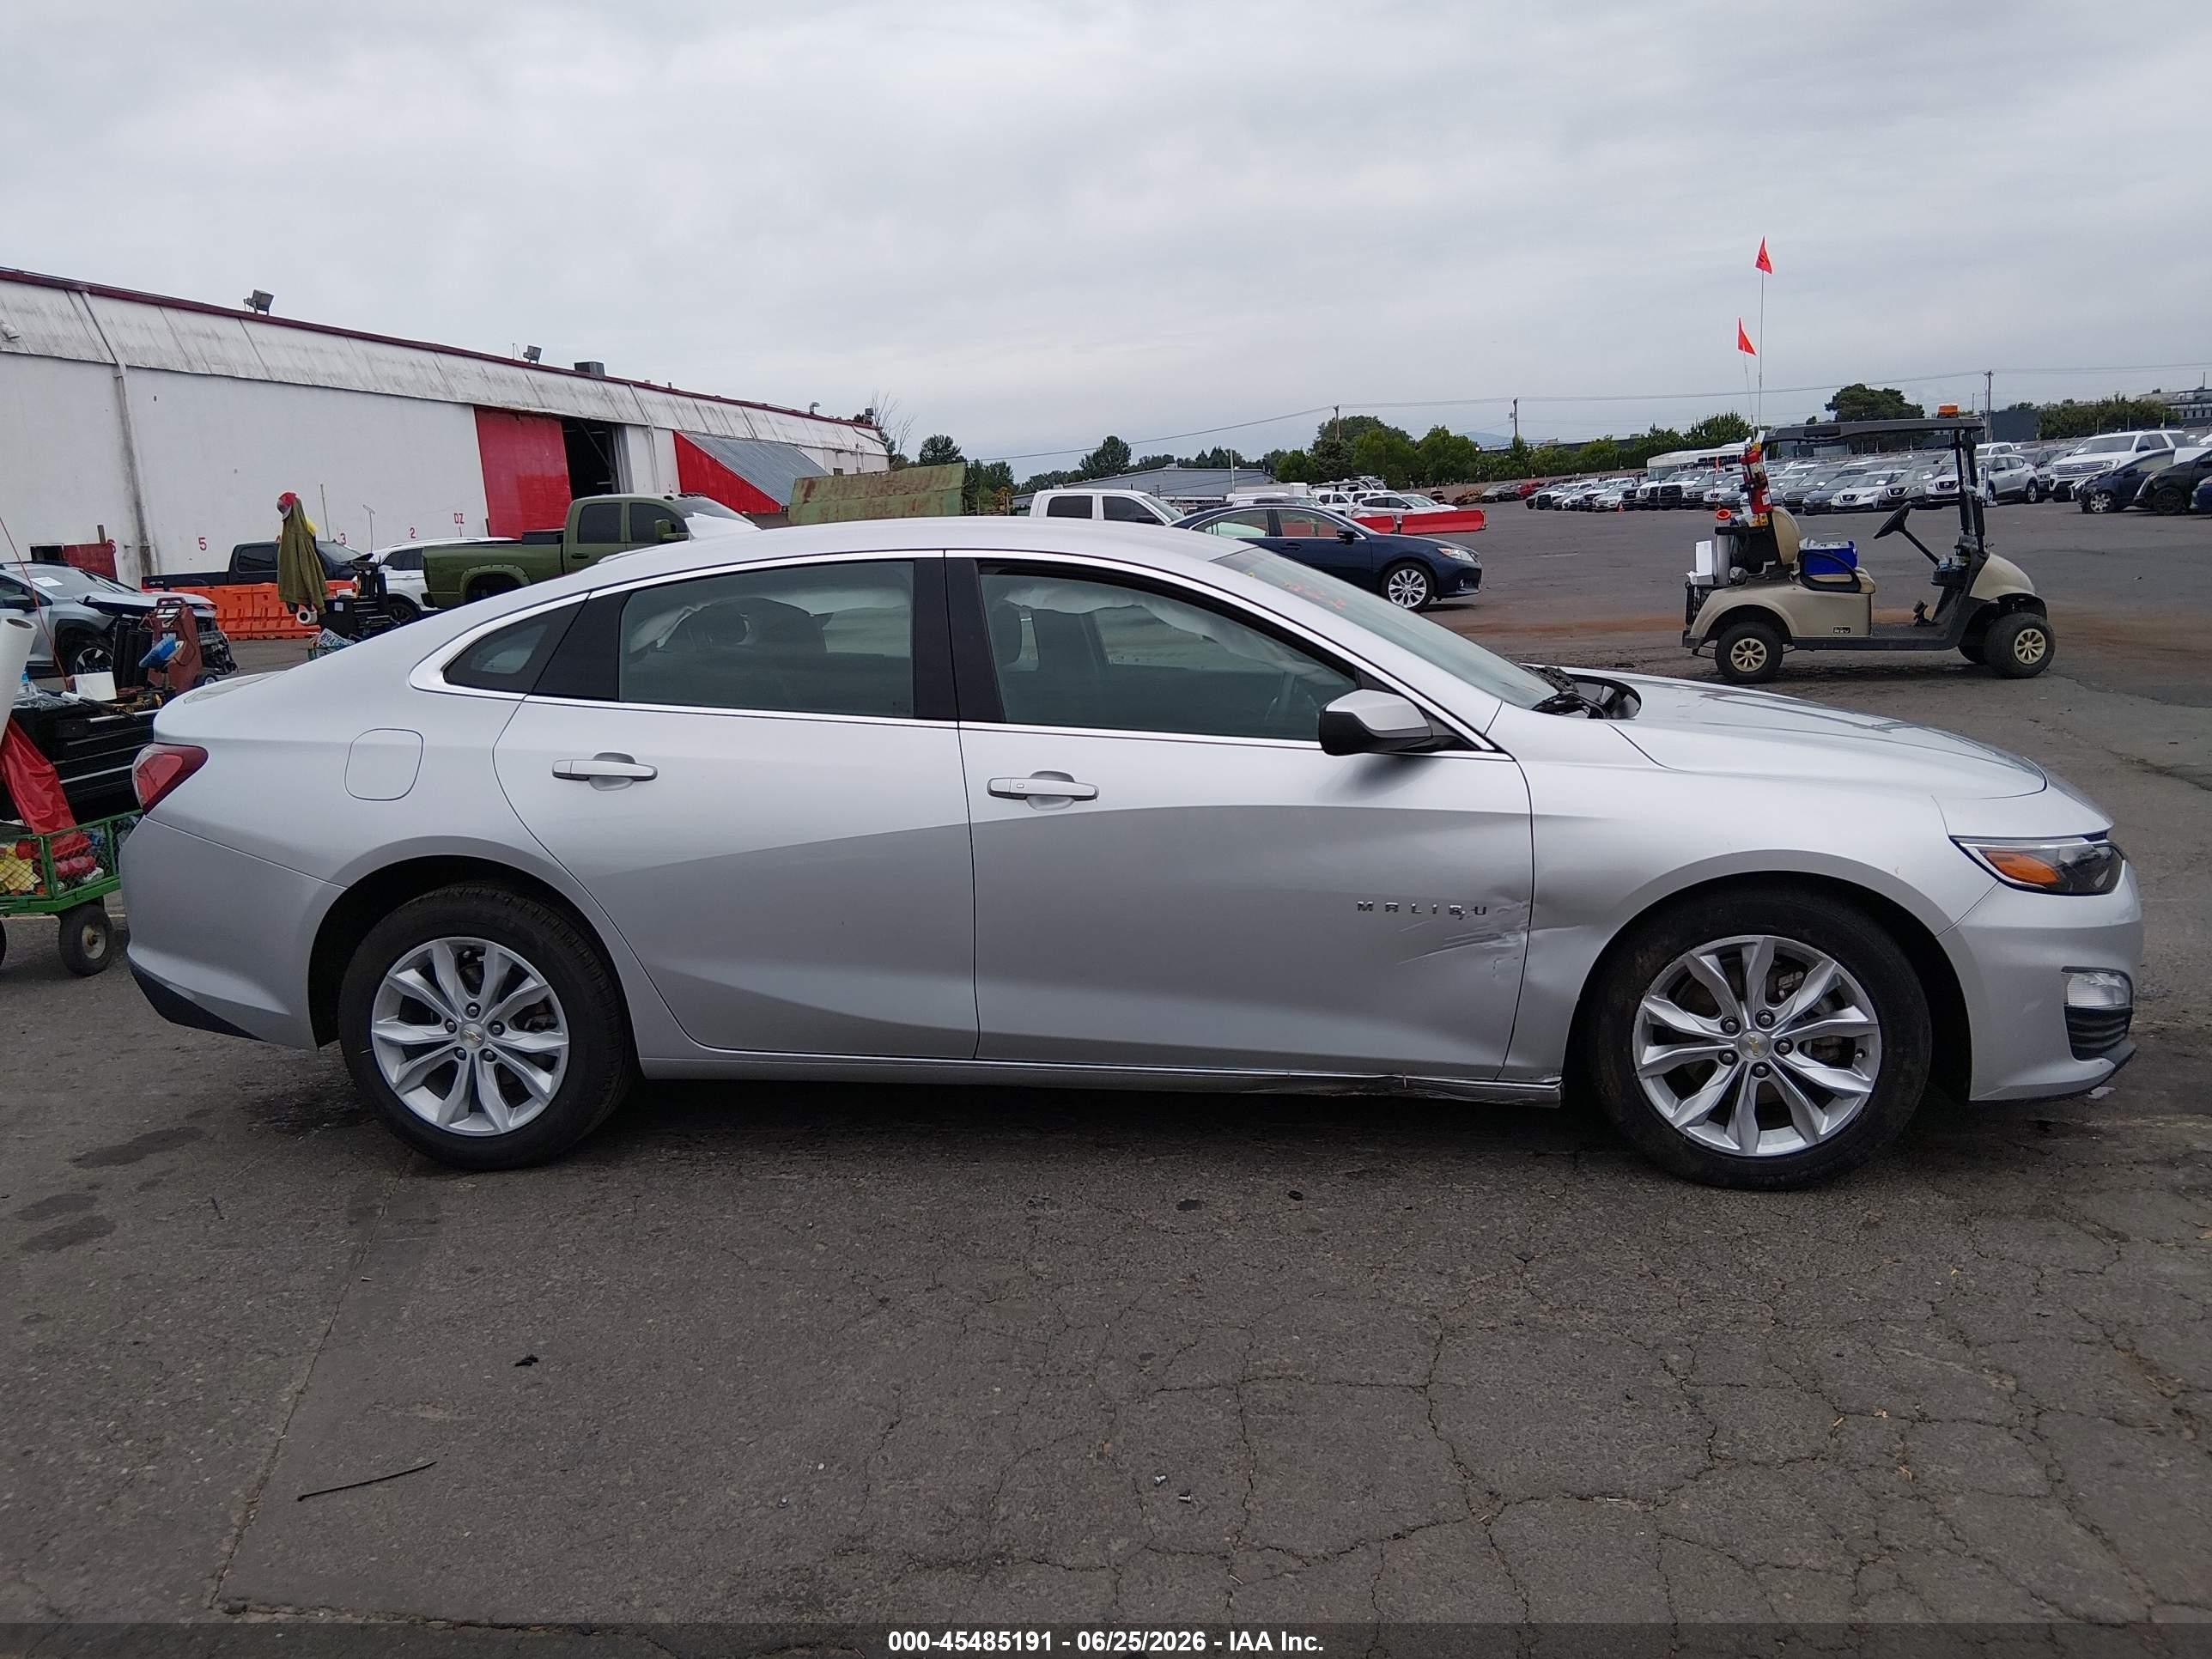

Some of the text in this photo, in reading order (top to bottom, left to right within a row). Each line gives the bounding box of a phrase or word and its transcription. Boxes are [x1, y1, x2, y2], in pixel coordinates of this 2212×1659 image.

[340, 532, 347, 545] 3
[410, 527, 416, 539] 2
[198, 537, 208, 551] 5
[1356, 900, 1488, 916] MALIBU
